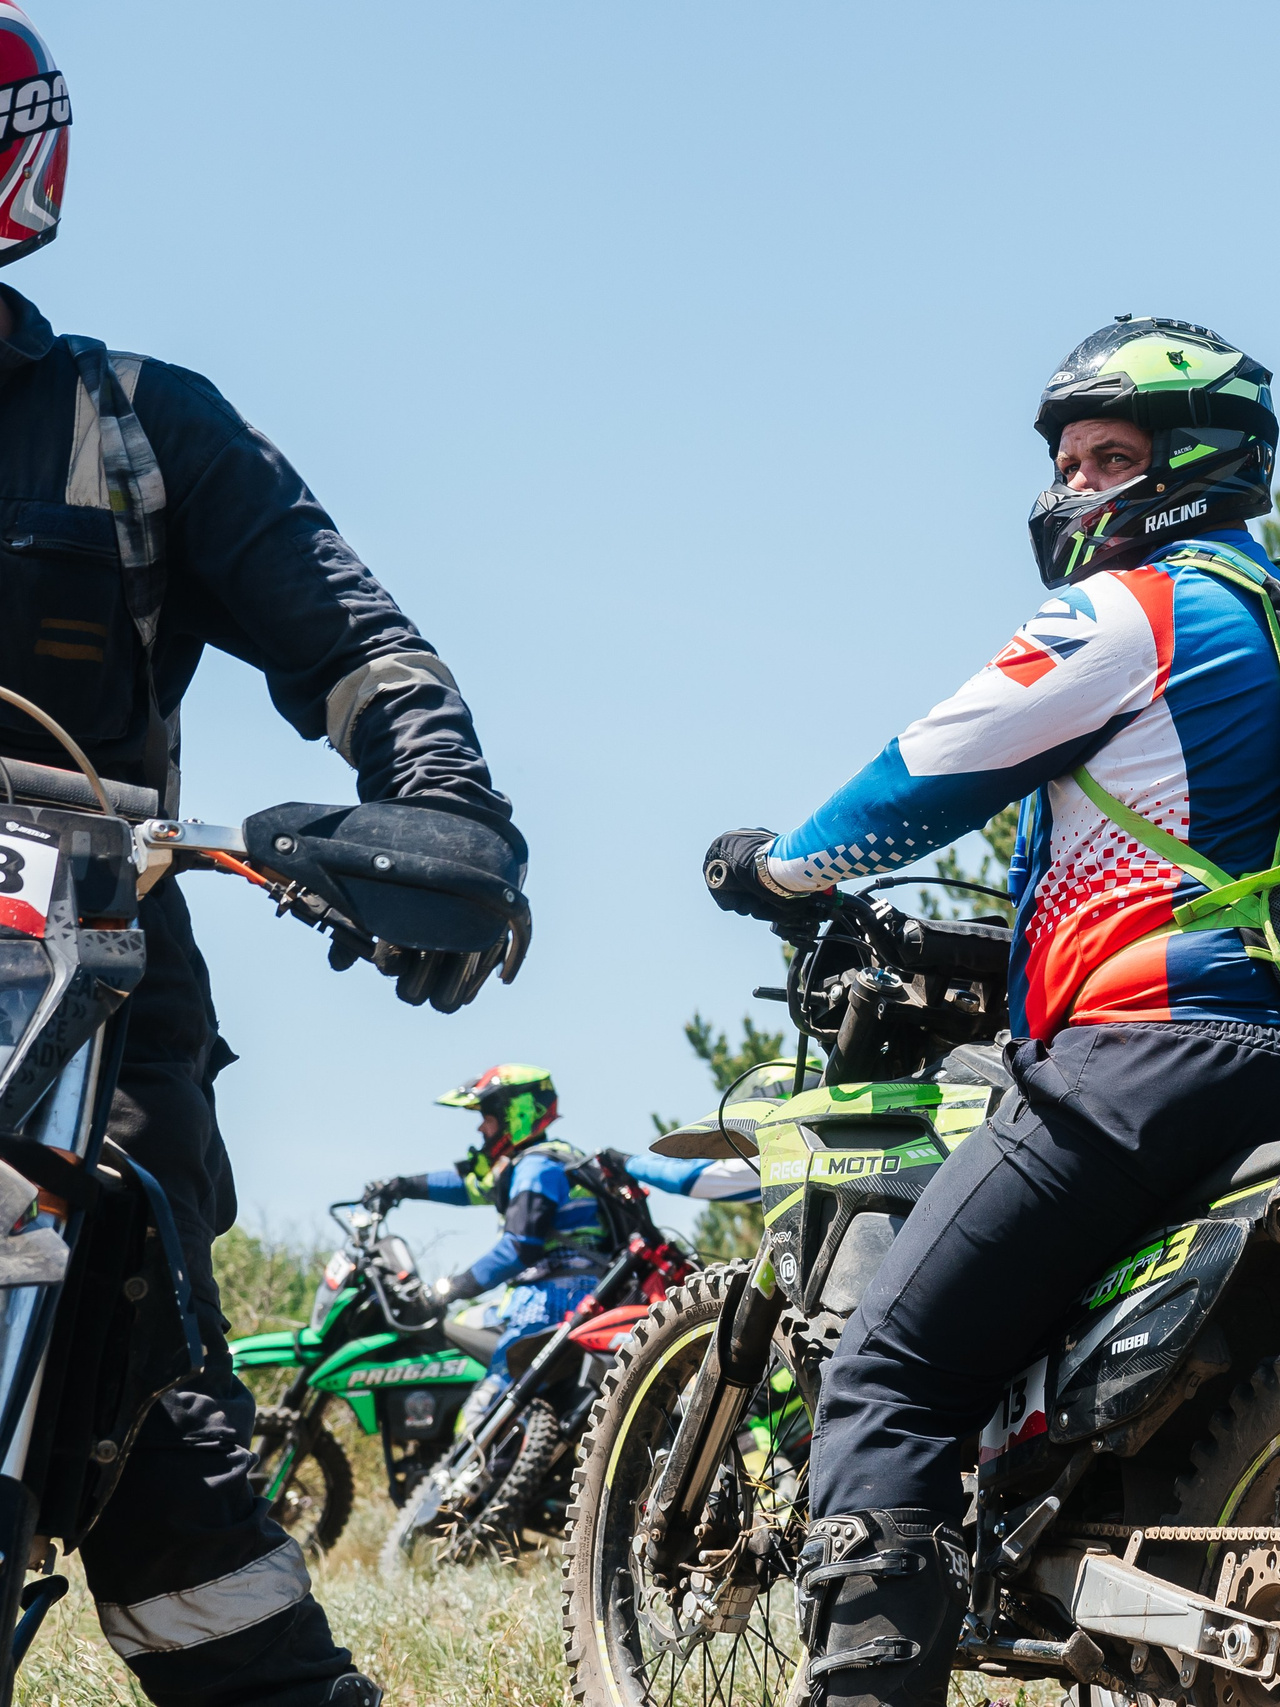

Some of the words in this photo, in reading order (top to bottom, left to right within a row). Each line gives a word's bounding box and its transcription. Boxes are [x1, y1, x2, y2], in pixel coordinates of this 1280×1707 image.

[1174, 446, 1193, 456] RACING
[1145, 499, 1208, 534] RACING
[770, 1155, 901, 1181] REGULMOTO
[1134, 1248, 1164, 1271] PRO
[1112, 1332, 1149, 1355] NIBBI
[348, 1359, 468, 1387] PROGASI
